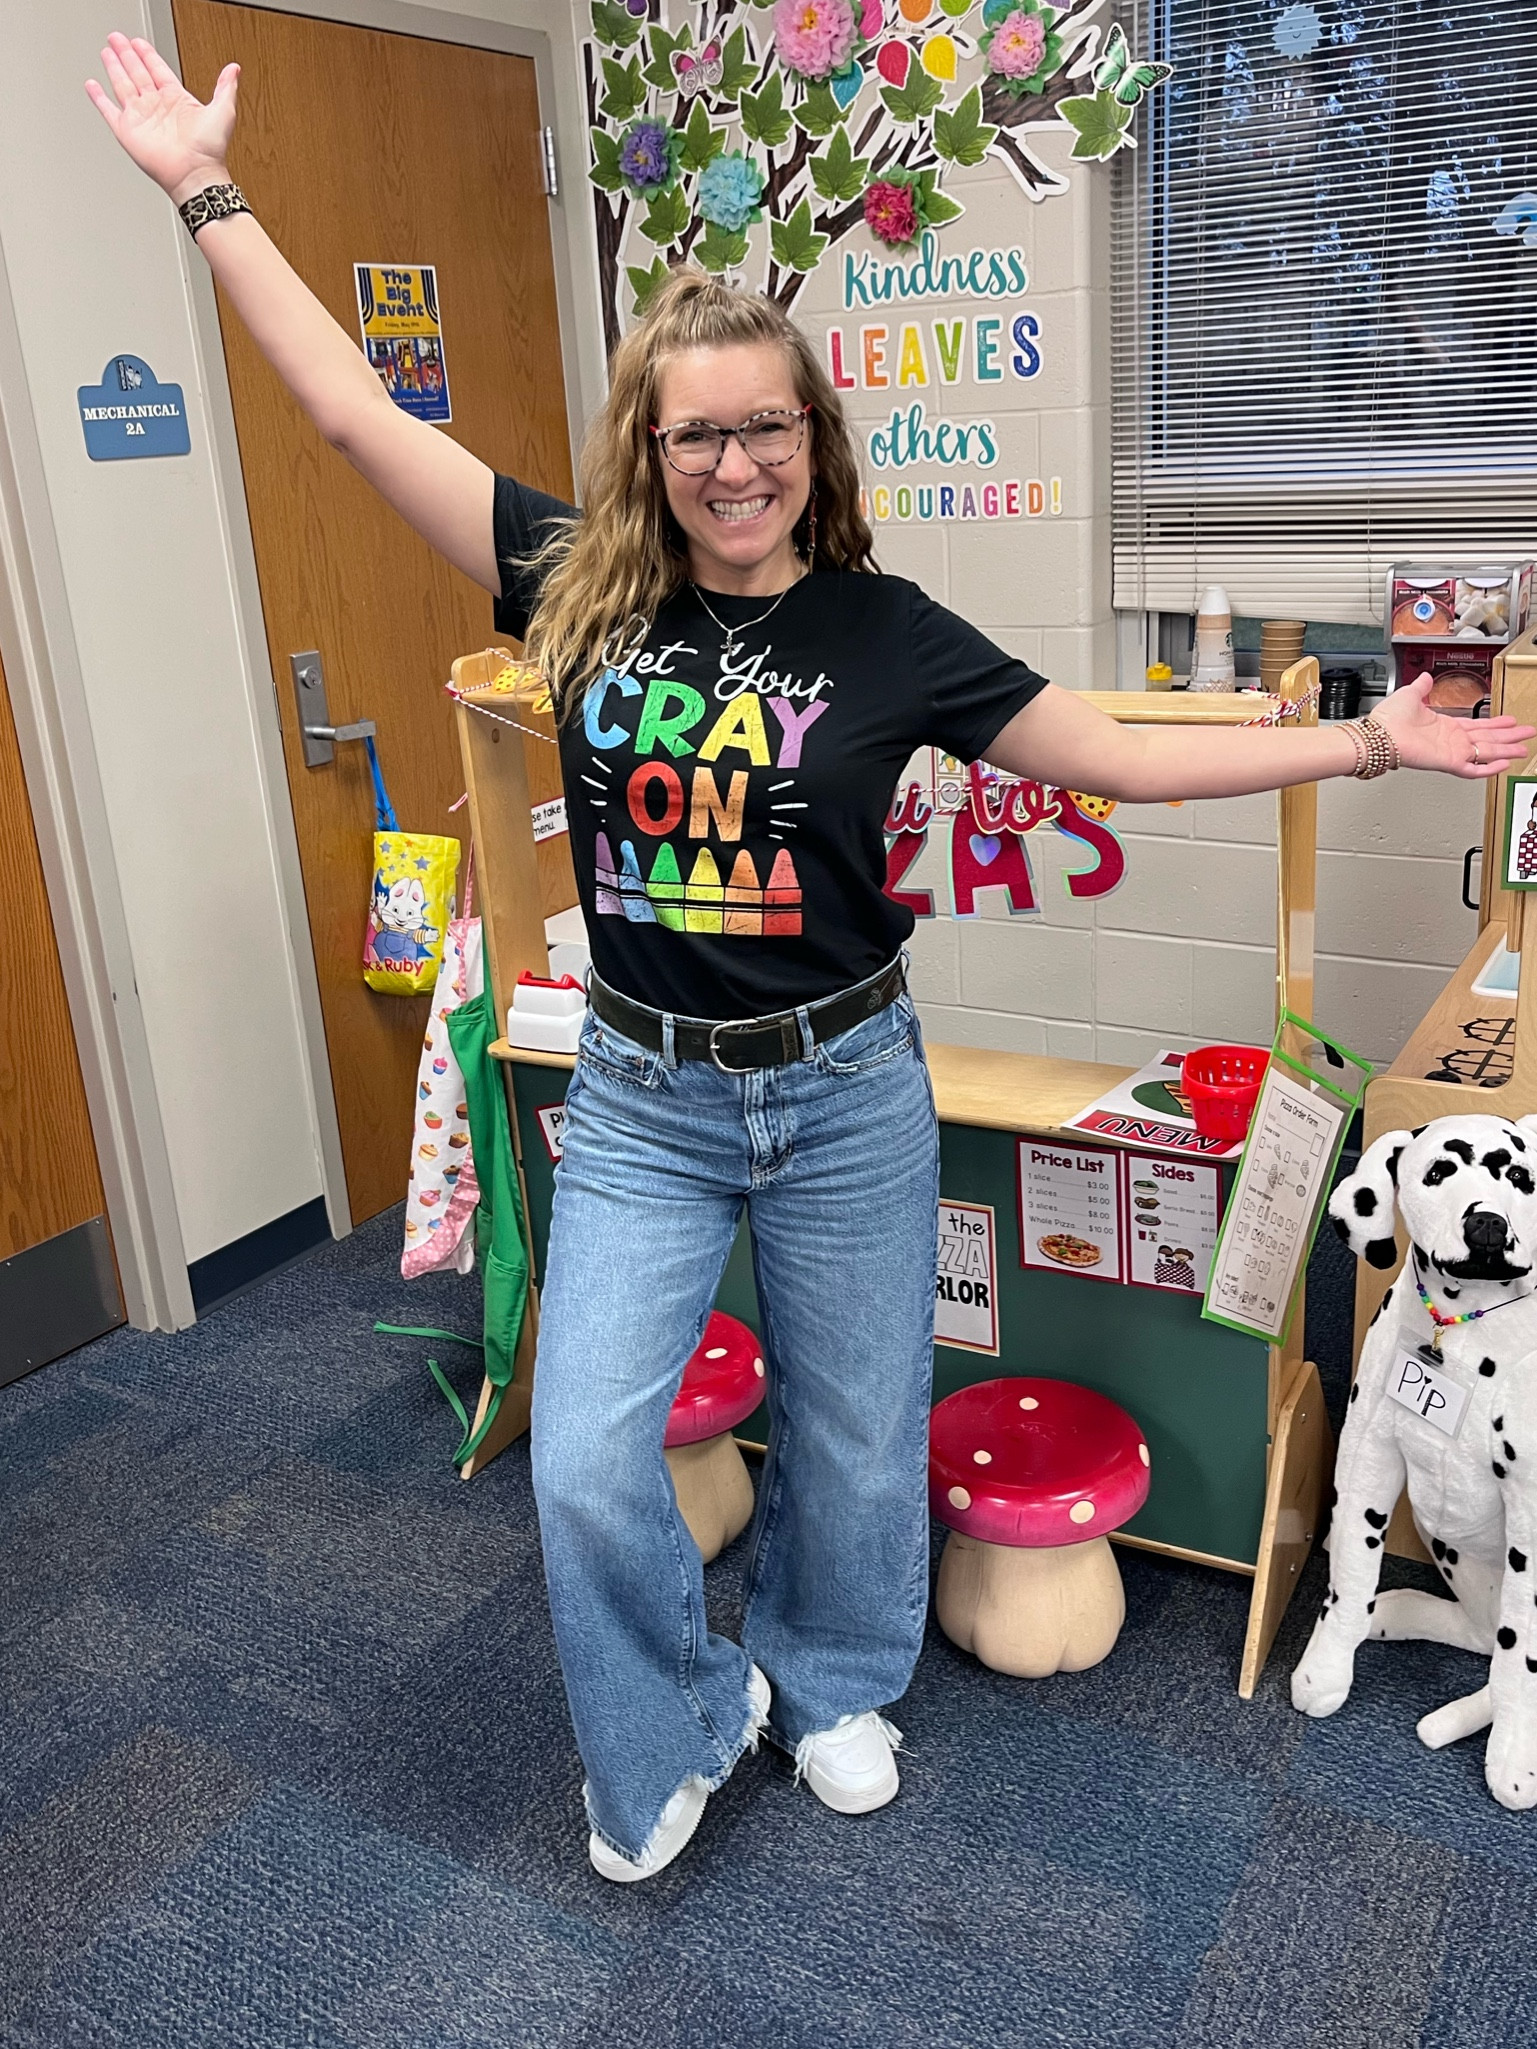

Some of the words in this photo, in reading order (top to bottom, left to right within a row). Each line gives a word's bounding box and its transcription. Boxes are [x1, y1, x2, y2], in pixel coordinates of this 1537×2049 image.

[381, 269, 412, 285] The
[845, 231, 1026, 308] Kindness
[386, 285, 411, 304] Big
[377, 303, 424, 317] Event
[831, 315, 1041, 388] LEAVES
[83, 404, 179, 421] MECHANICAL
[126, 423, 145, 436] 2A
[871, 404, 995, 468] others
[860, 480, 1062, 519] COURAGED!
[602, 613, 698, 679] Get
[714, 642, 834, 702] Your
[583, 668, 830, 768] CRAY
[627, 761, 749, 842] ON
[969, 759, 1062, 834] to
[532, 812, 541, 823] se
[543, 805, 562, 818] take
[881, 790, 1128, 920] ZAS
[375, 961, 383, 971] &
[384, 957, 424, 977] Ruby
[1098, 1116, 1221, 1151] MENU
[1031, 1150, 1073, 1169] Price
[1076, 1157, 1105, 1174] List
[1152, 1163, 1195, 1182] Sides
[1087, 1181, 1109, 1191] $3.00
[1088, 1195, 1110, 1206] $5.00
[948, 1213, 985, 1236] the
[1029, 1215, 1053, 1225] Whole
[1054, 1218, 1076, 1229] Pizza
[1088, 1210, 1110, 1220] $8.00
[937, 1234, 989, 1279] ZZA
[935, 1275, 990, 1309] RLOR
